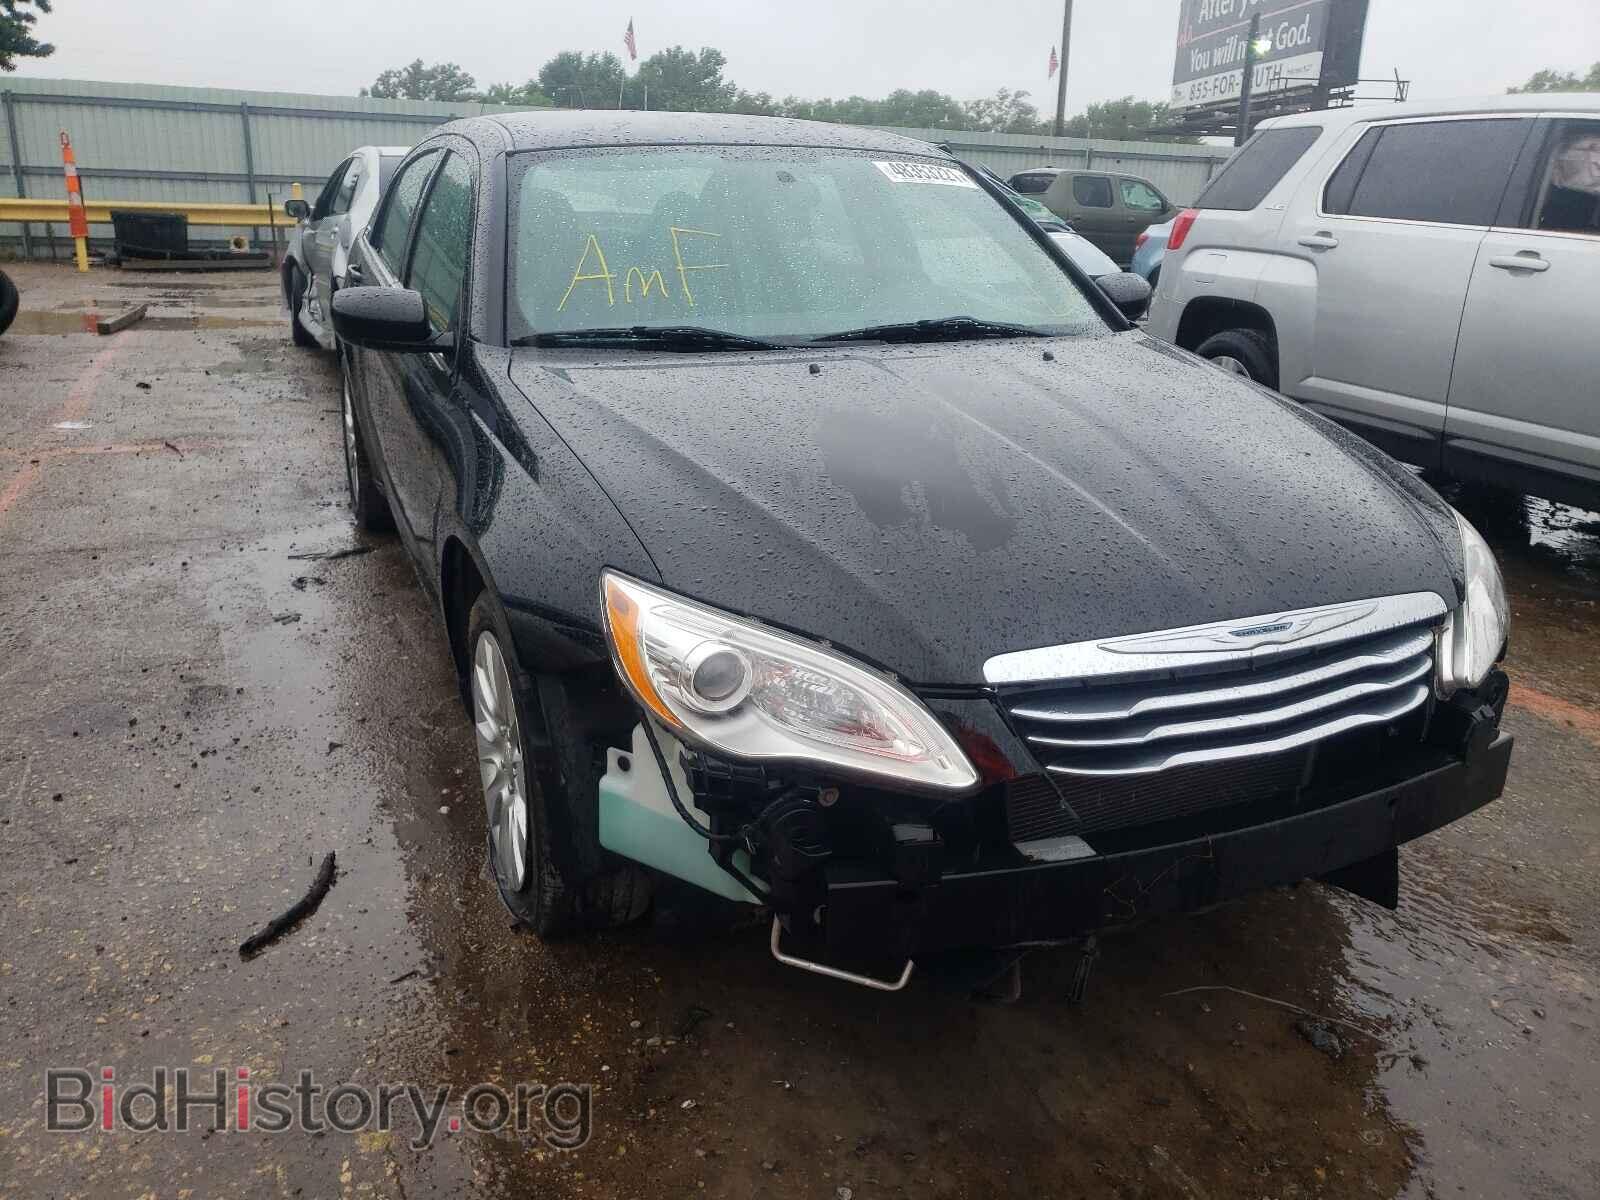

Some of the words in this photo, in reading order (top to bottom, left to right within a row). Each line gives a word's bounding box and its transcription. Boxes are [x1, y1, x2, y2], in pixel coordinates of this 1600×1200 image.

[1190, 49, 1210, 73] You
[1214, 34, 1237, 66] will
[1277, 14, 1312, 50] God.
